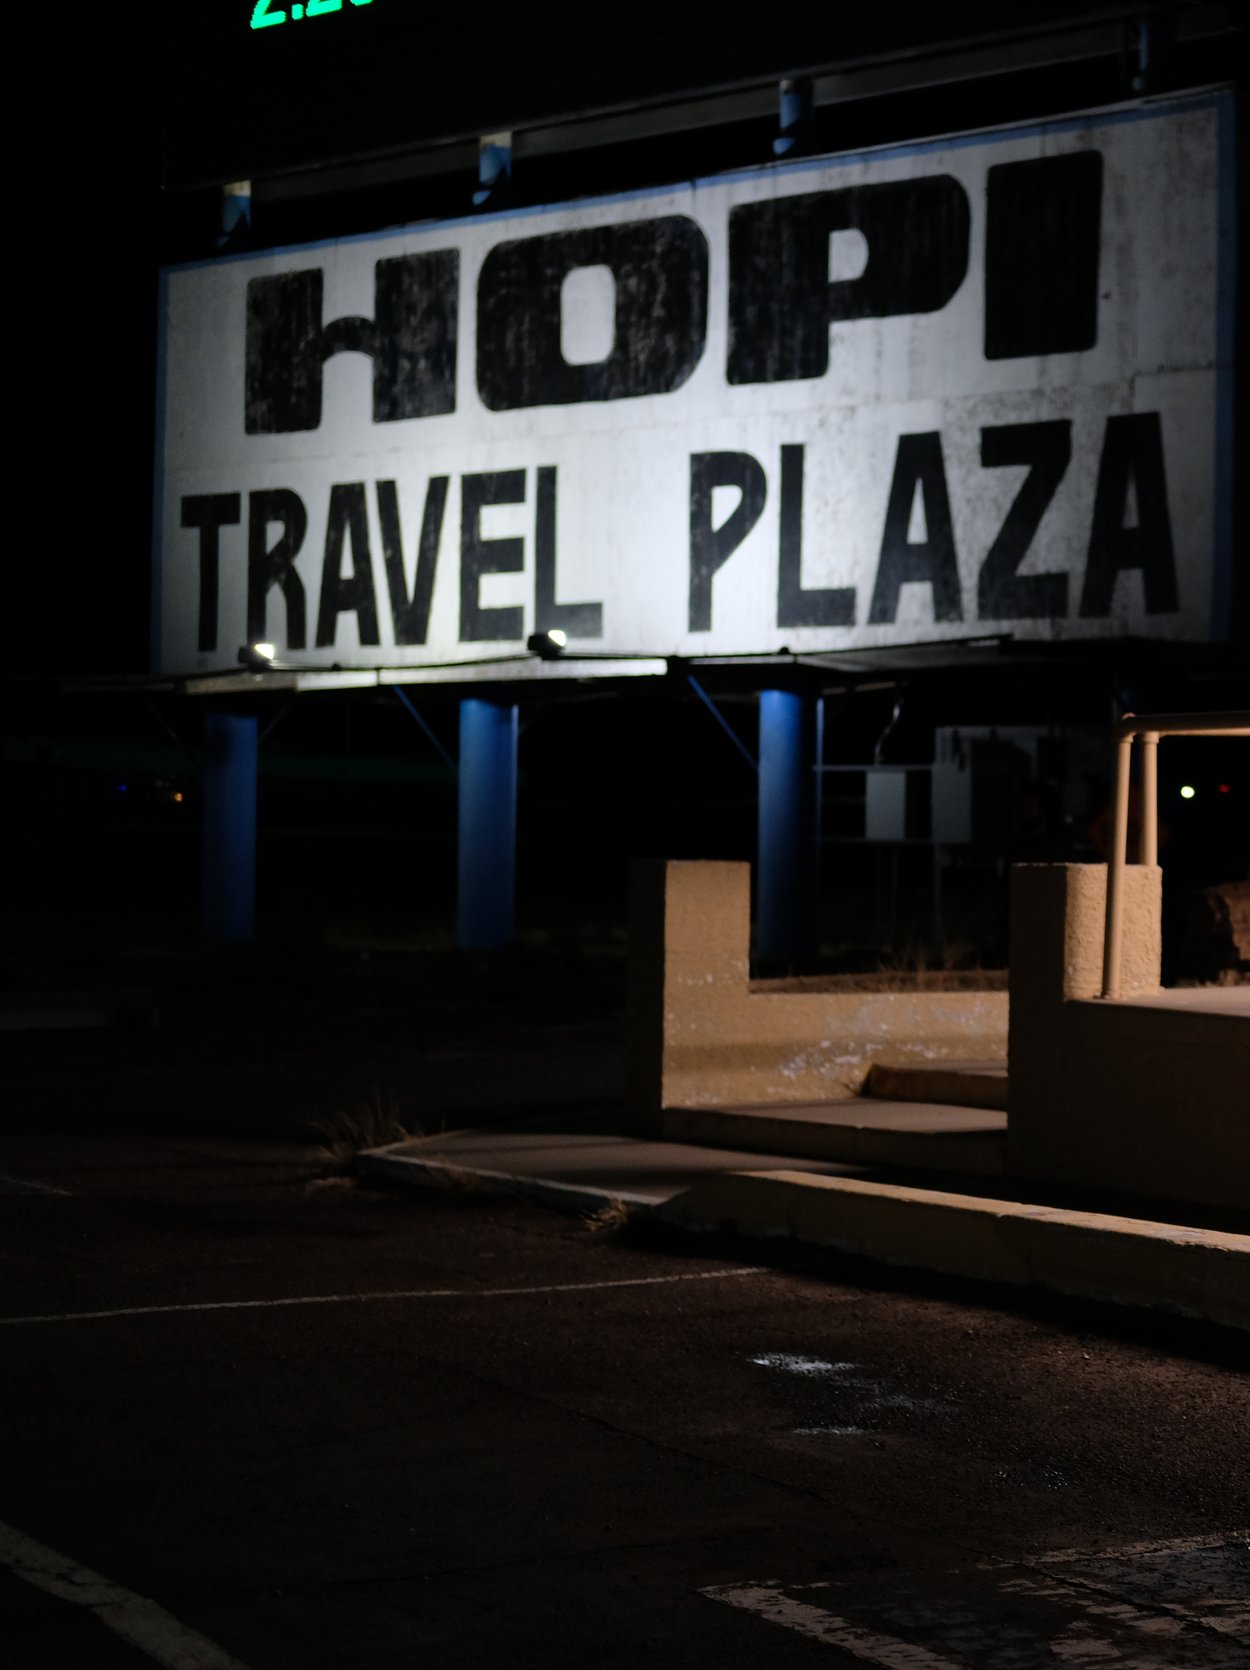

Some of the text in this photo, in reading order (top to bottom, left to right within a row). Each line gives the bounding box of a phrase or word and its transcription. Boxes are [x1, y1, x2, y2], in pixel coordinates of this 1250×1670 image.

[244, 151, 1105, 434] HOPI
[180, 412, 1180, 652] TRAVEL PLAZA
